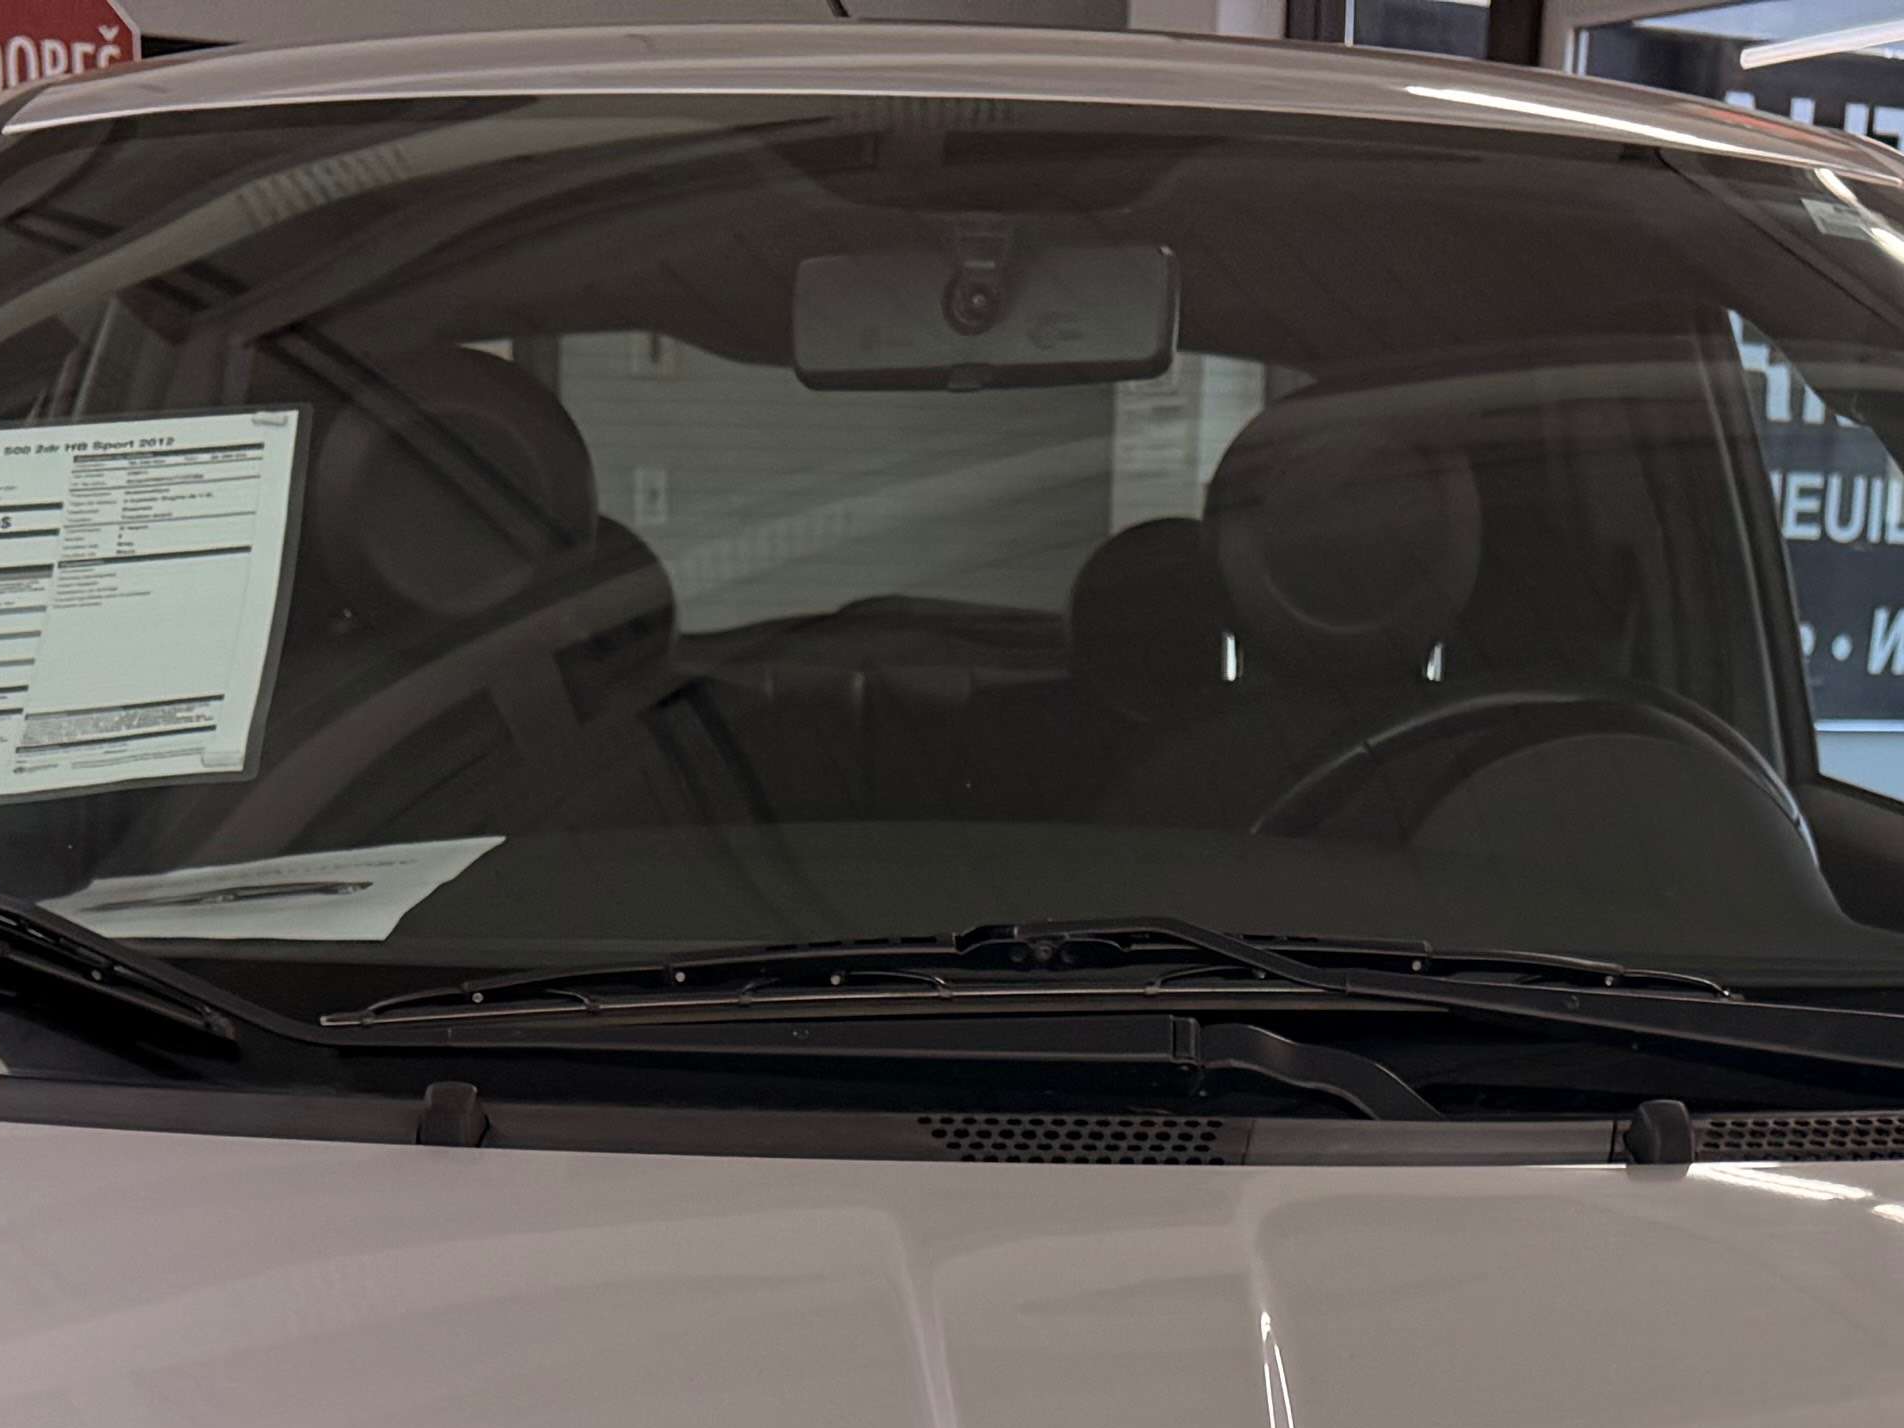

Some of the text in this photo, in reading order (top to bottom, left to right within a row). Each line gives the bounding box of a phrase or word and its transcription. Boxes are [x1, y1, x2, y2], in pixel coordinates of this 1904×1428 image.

[3, 446, 30, 456] 500
[92, 439, 135, 452] Sport
[138, 436, 175, 448] 2012
